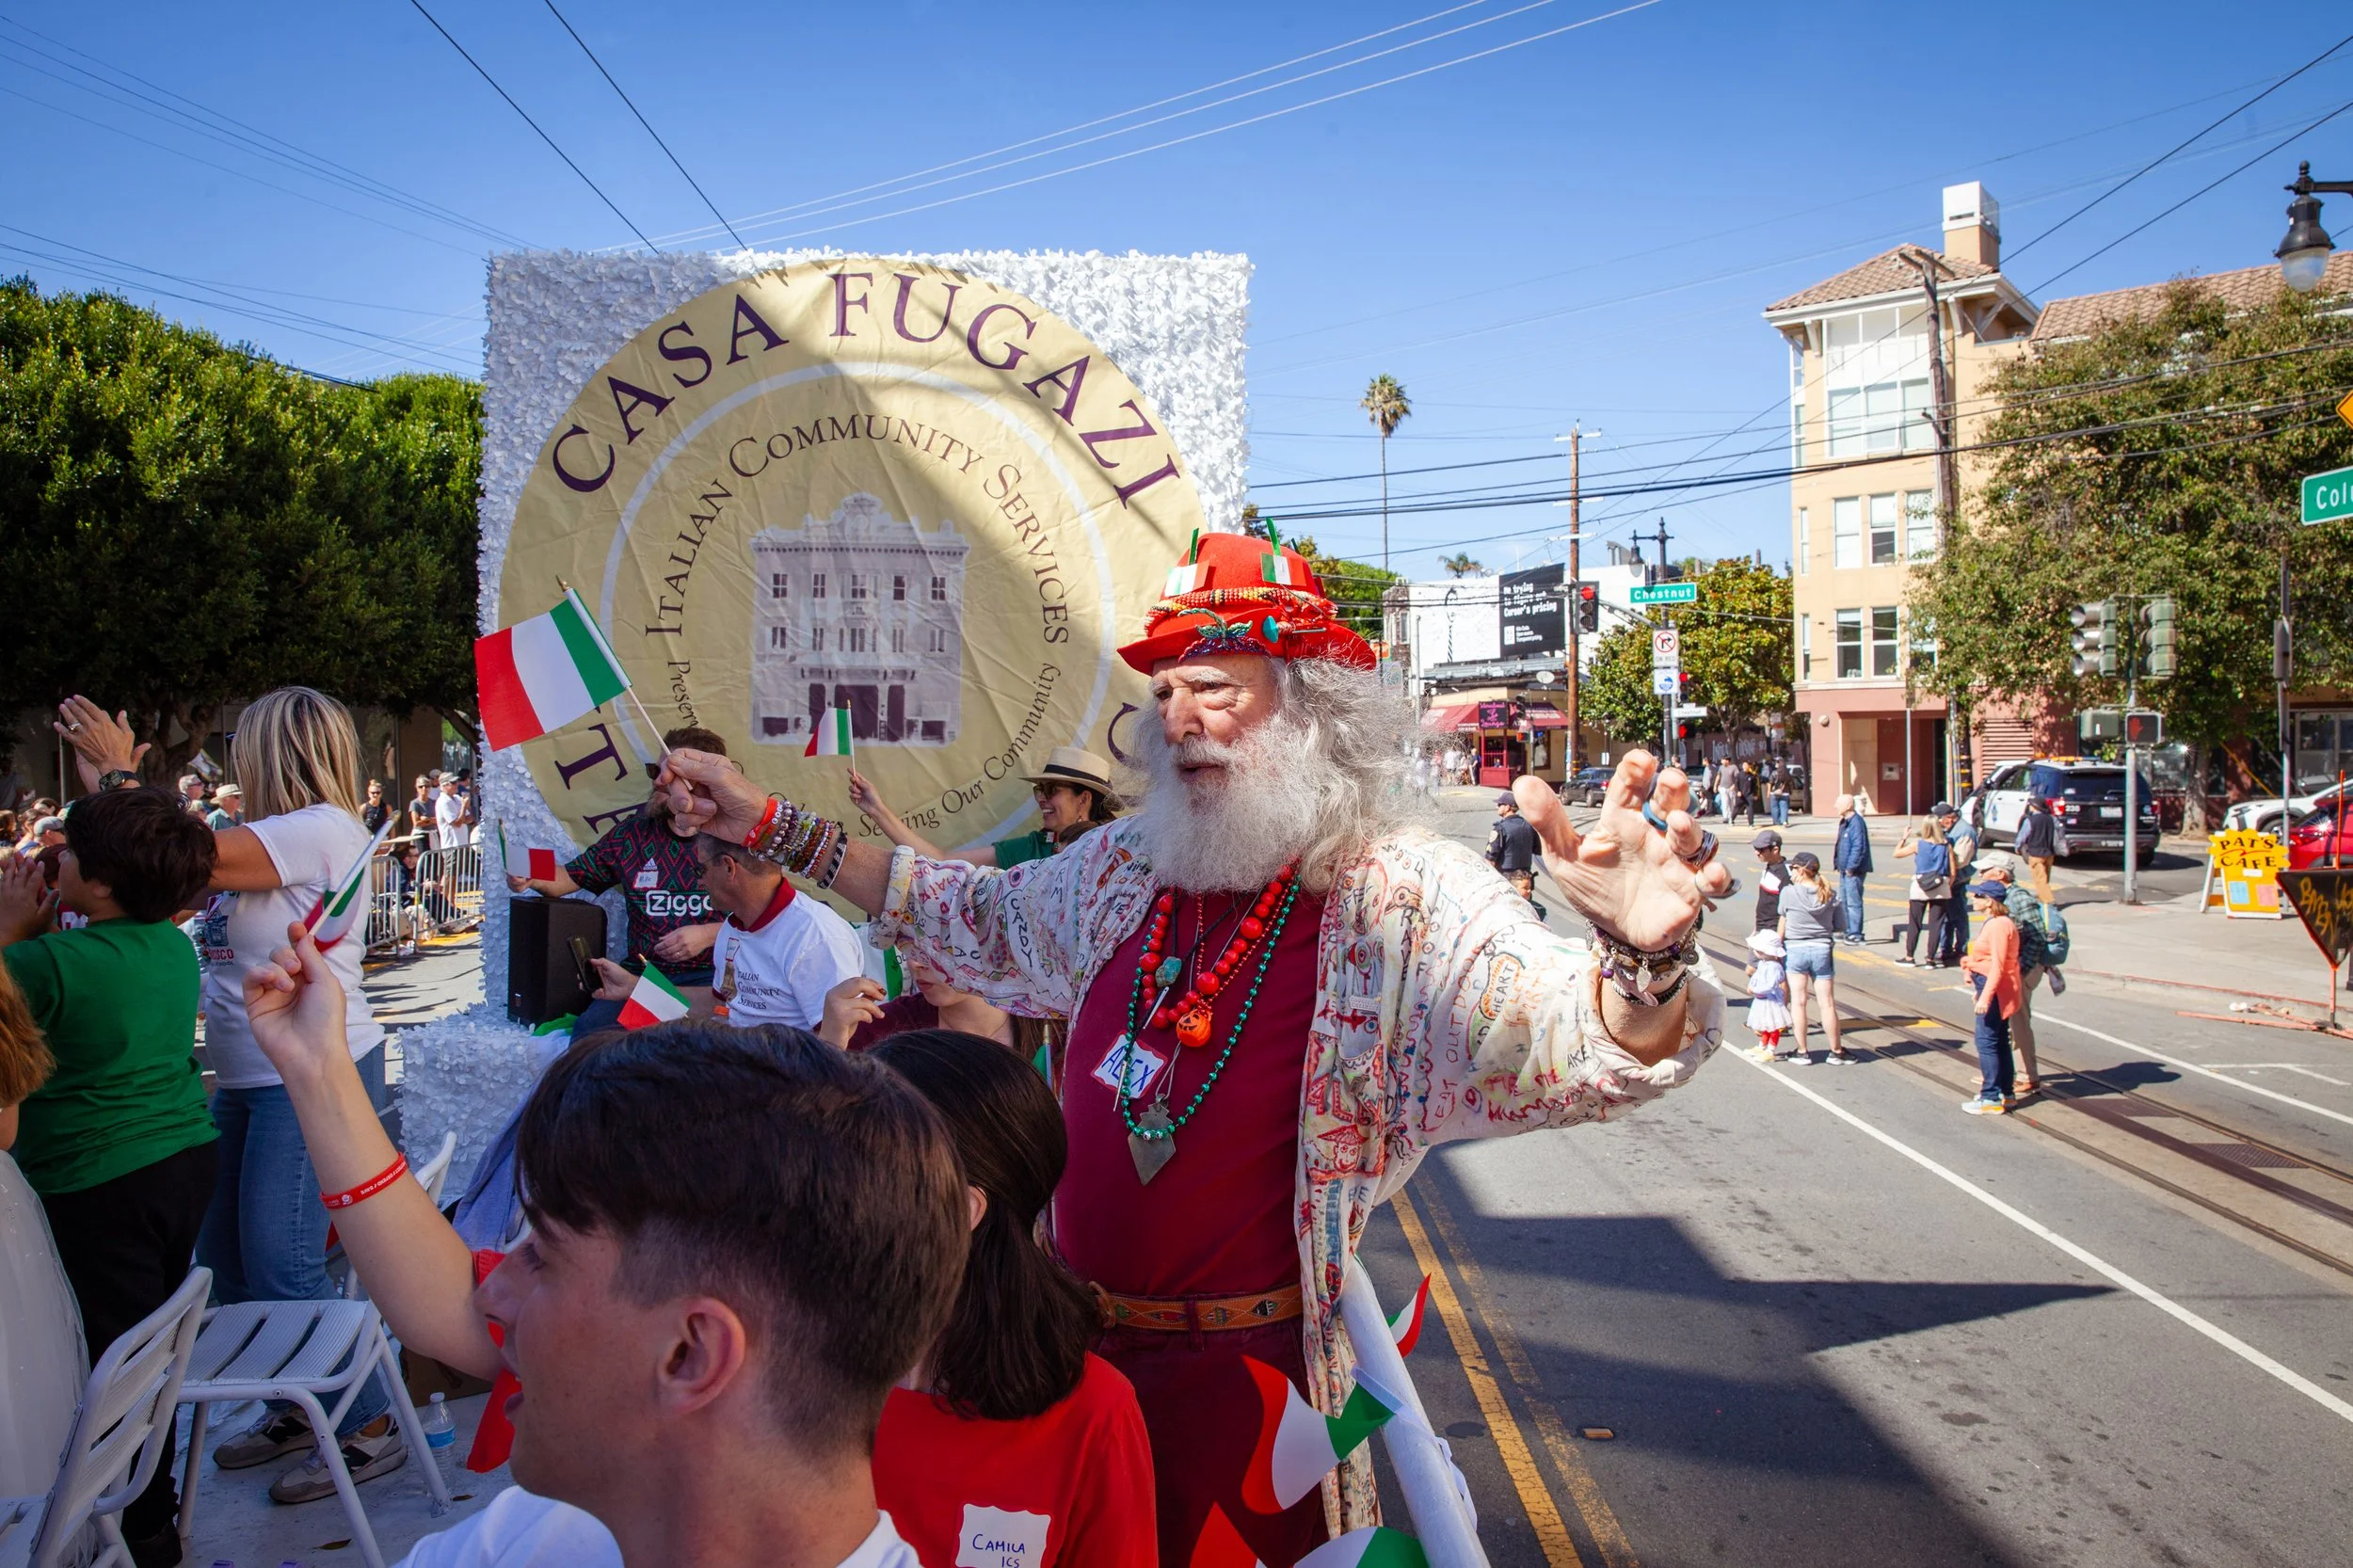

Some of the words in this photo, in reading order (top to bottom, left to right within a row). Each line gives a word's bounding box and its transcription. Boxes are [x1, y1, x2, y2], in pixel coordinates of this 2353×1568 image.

[552, 294, 790, 492] CASA
[826, 272, 1180, 510] FUGAZI
[2315, 481, 2353, 509] Col
[645, 478, 733, 637] ITALIAN
[729, 413, 984, 478] COMMUNITY
[982, 464, 1069, 644] SERVICES
[1634, 587, 1691, 600] Chestnut
[858, 808, 940, 838] Seing
[941, 779, 984, 814] Our
[984, 663, 1062, 780] Community
[2219, 837, 2275, 851] PAT'S
[2220, 856, 2277, 870] CAFE
[1010, 898, 1033, 968] CANDY
[1493, 962, 1515, 1015] HEART
[972, 1533, 1026, 1555] CAMILA
